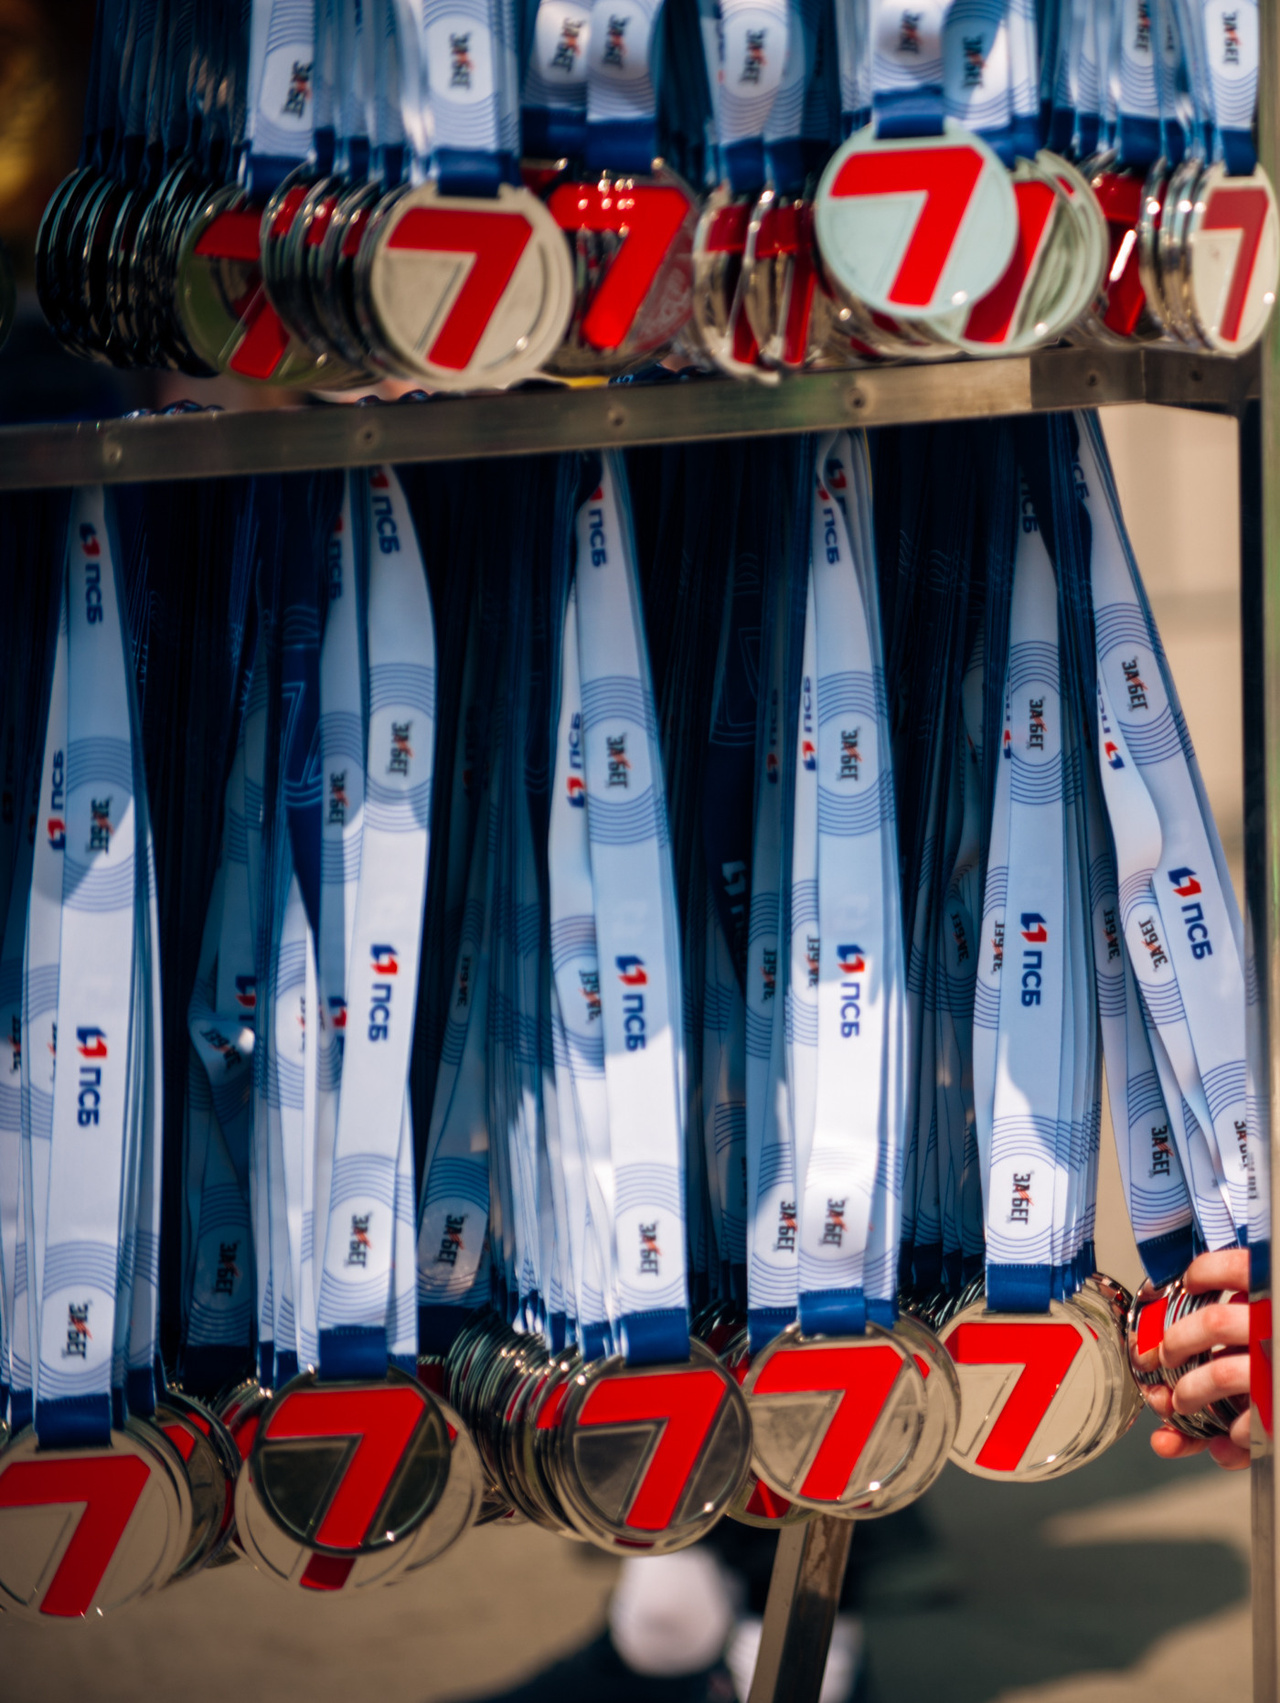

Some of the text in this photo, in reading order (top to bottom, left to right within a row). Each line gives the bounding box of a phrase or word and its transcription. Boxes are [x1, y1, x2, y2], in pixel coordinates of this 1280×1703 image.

[449, 33, 471, 90] ЗАБЕГ
[551, 16, 584, 73] ЗАБЕГ
[602, 14, 629, 69] ЗАБЕГ
[741, 28, 767, 83] ЗАБЕГ
[1223, 10, 1240, 66] ЗАБЕГ
[829, 146, 985, 306] 7
[387, 208, 532, 369] 7
[547, 182, 690, 350] 7
[1203, 188, 1270, 342] 7
[372, 496, 400, 554] ПСБ
[588, 508, 607, 567] ПСБ
[824, 507, 840, 565] ПСБ
[85, 563, 103, 625] ПСБ
[1122, 659, 1149, 710] ЗАБЕГ
[389, 722, 410, 777] ЗАБЕГ
[568, 712, 582, 769] ПСБ
[1029, 698, 1044, 751] ЗАБЕГ
[50, 749, 64, 811] ПСБ
[606, 736, 628, 788] ЗАБЕГ
[841, 729, 858, 781] ЗАБЕГ
[90, 798, 110, 854] ЗАБЕГ
[330, 771, 347, 827] ЗАБЕГ
[1103, 908, 1121, 961] ЗАБЕГ
[1138, 918, 1168, 969] ЗАБЕГ
[1181, 902, 1213, 960] ПСБ
[763, 947, 777, 1001] ЗАБЕГ
[1021, 950, 1042, 1007] ПСБ
[368, 984, 391, 1042] ПСБ
[623, 994, 646, 1052] ПСБ
[840, 982, 860, 1039] ПСБ
[77, 1067, 102, 1129] ПСБ
[1151, 1125, 1170, 1176] ЗАБЕГ
[777, 1201, 796, 1253] ЗАБЕГ
[823, 1198, 845, 1248] ЗАБЕГ
[1012, 1173, 1031, 1225] ЗАБЕГ
[349, 1214, 369, 1269] ЗАБЕГ
[438, 1214, 464, 1267] ЗАБЕГ
[639, 1222, 658, 1276] ЗАБЕГ
[215, 1242, 238, 1297] ЗАБЕГ
[67, 1303, 88, 1360] ЗАБЕГ
[753, 1345, 903, 1500] 7
[944, 1323, 1083, 1471] 7
[266, 1387, 426, 1548] 7
[577, 1371, 727, 1530] 7
[0, 1454, 151, 1617] 7
